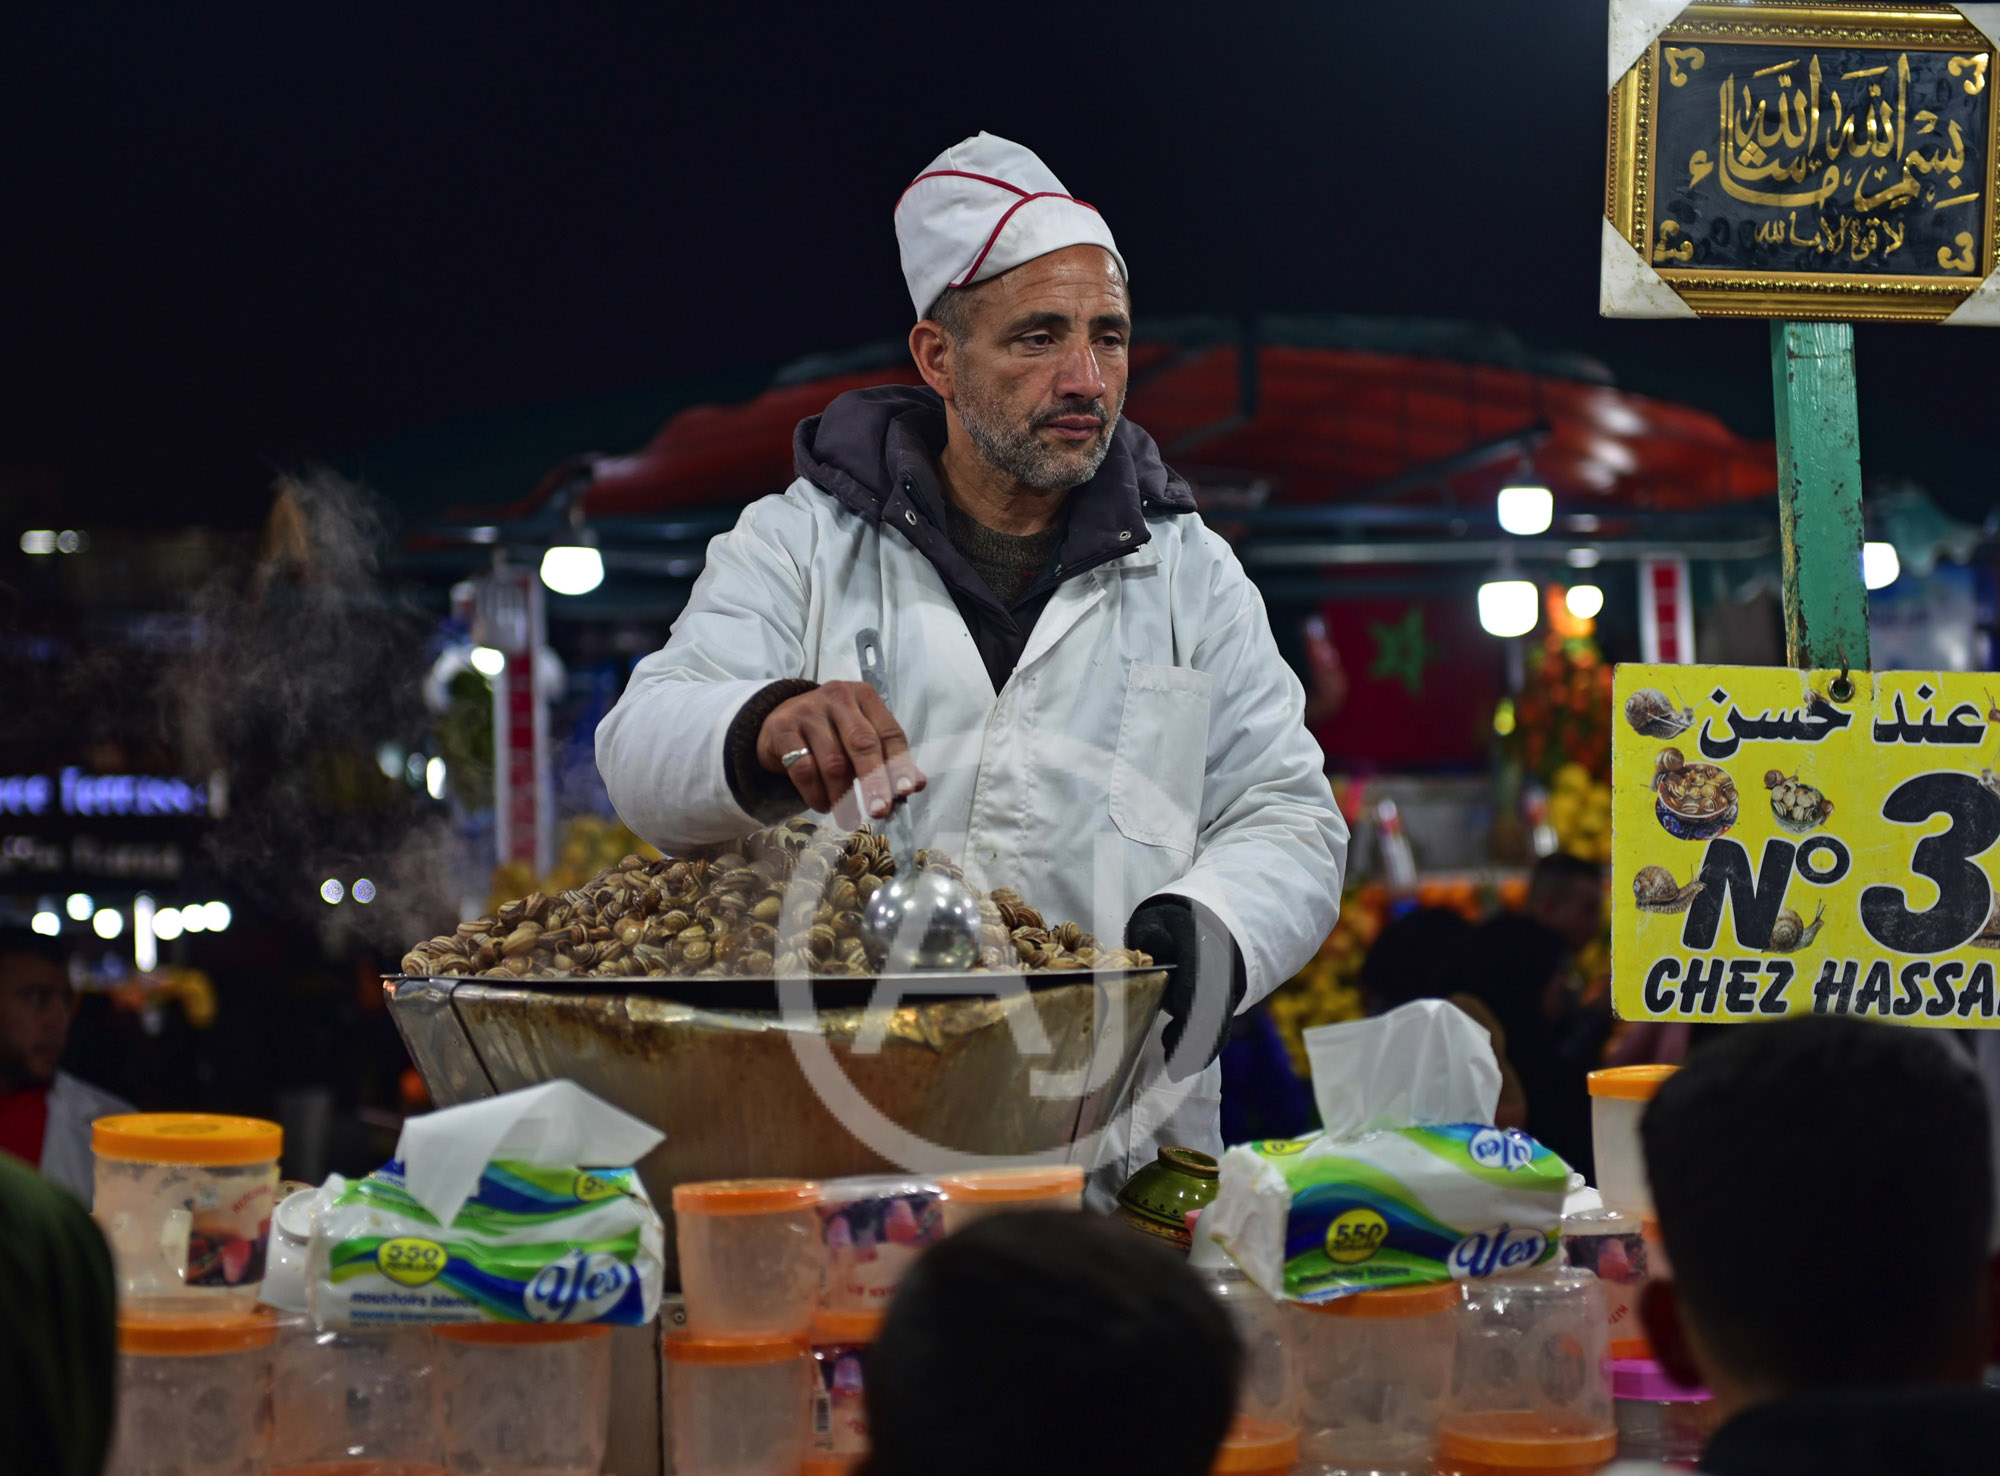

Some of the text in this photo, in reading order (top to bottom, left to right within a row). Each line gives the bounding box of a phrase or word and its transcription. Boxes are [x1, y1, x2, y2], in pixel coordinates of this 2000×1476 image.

[1701, 684, 1986, 760] عند حسن
[1861, 772, 2000, 953] 3
[1645, 958, 2000, 1016] CHEZ HASSA
[388, 1244, 439, 1262] 550
[1337, 1222, 1383, 1243] 550
